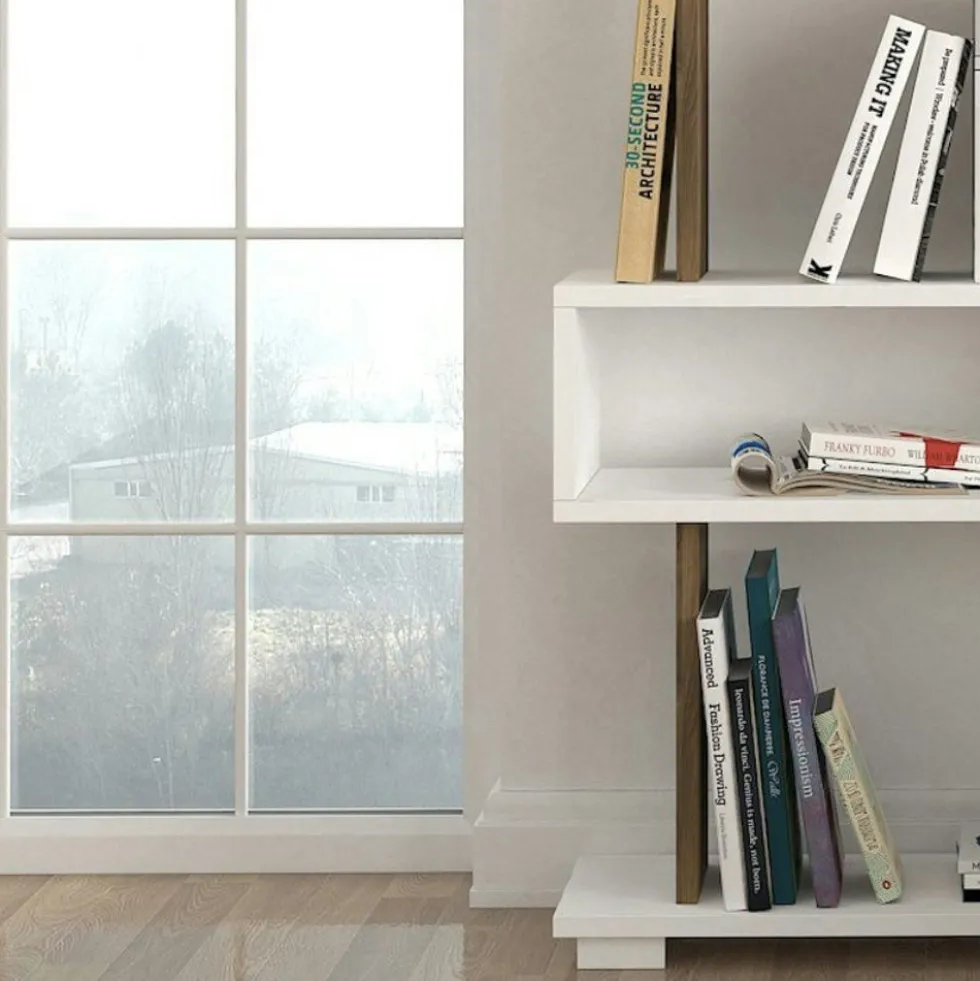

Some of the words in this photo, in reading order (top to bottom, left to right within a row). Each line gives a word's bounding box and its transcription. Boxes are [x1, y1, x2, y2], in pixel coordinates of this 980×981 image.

[874, 27, 913, 98] MAKING
[624, 82, 647, 169] 30-SECOND
[868, 97, 888, 118] IT
[638, 83, 662, 200] ARCHITECTURE
[824, 441, 861, 455] FRANKY
[864, 443, 896, 458] FURBO
[701, 628, 719, 689] Advanced
[709, 703, 723, 753] Fashion
[739, 731, 748, 743] da
[789, 698, 814, 799] Impressionism
[713, 753, 728, 807] Drawing
[743, 773, 753, 807] Genius
